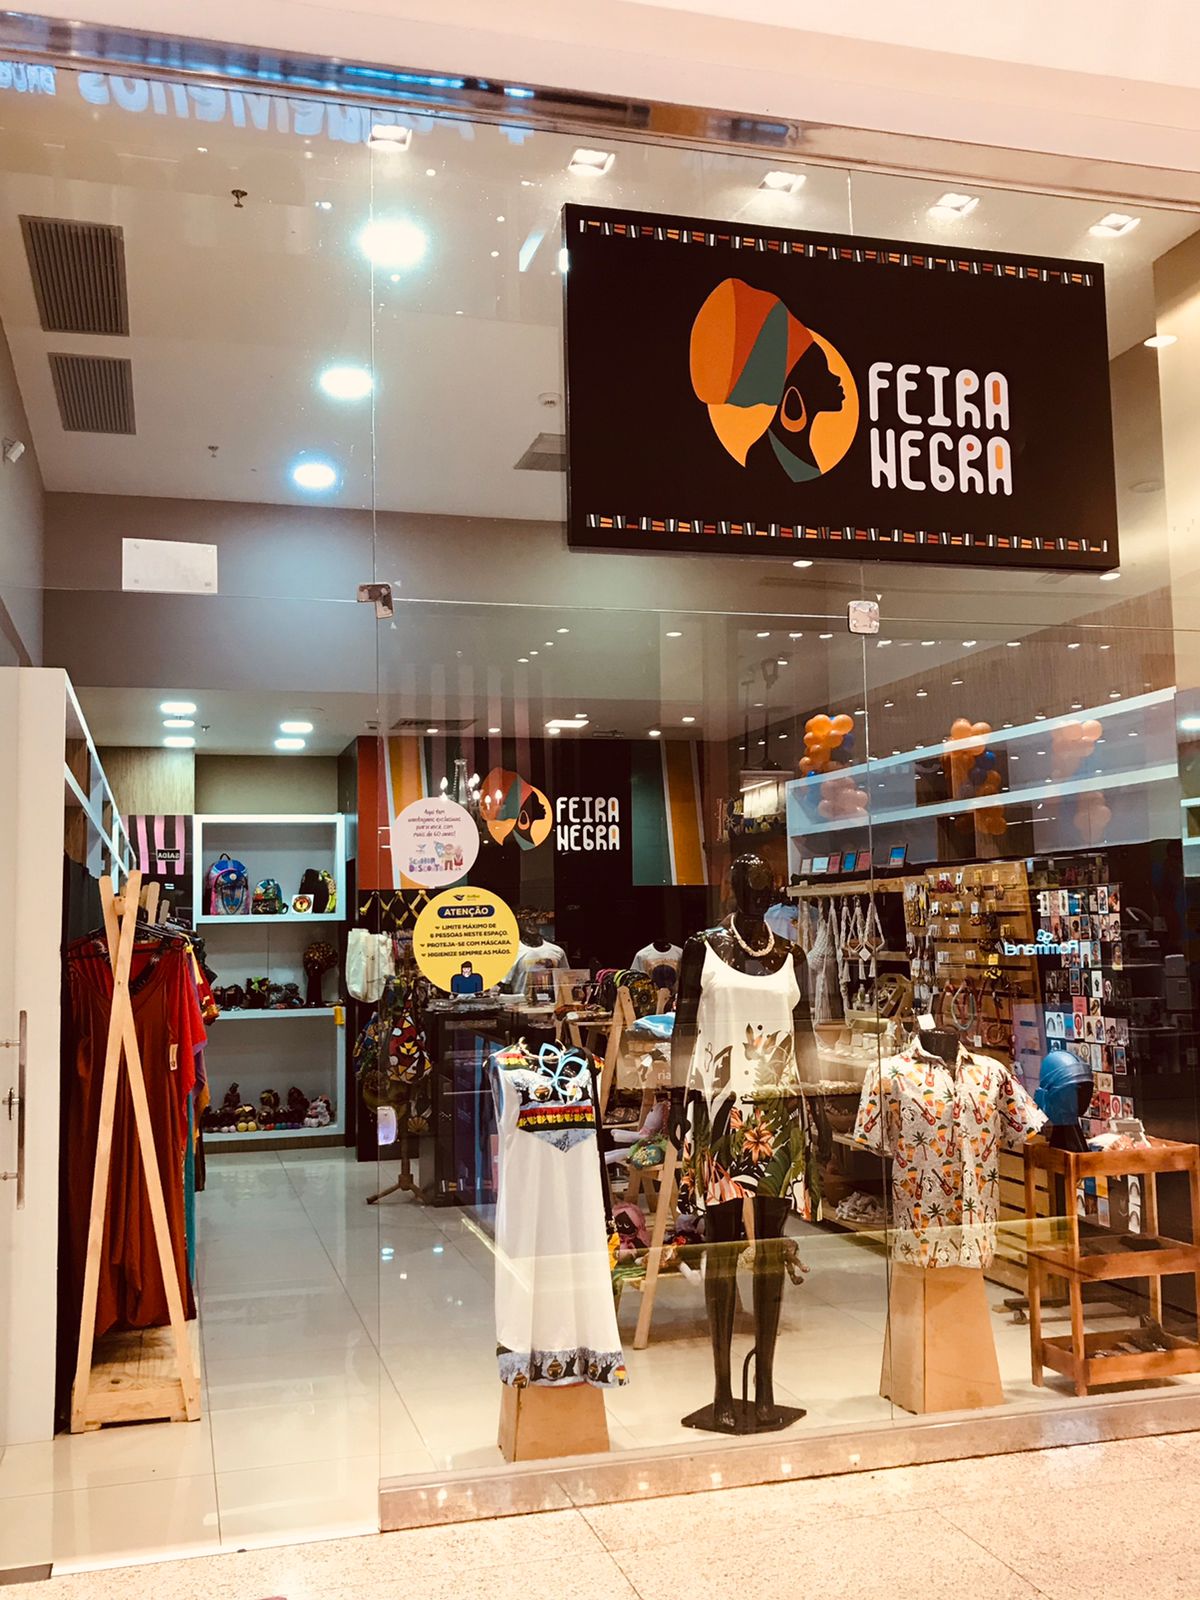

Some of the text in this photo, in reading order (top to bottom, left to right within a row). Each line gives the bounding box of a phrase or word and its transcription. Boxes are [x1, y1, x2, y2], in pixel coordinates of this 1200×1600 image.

[868, 362, 1010, 430] FEIRA
[870, 428, 1012, 496] NEGRA
[556, 797, 620, 822] FEIRA
[556, 824, 620, 850] NEGRA
[444, 906, 488, 917] ATENÇÃO
